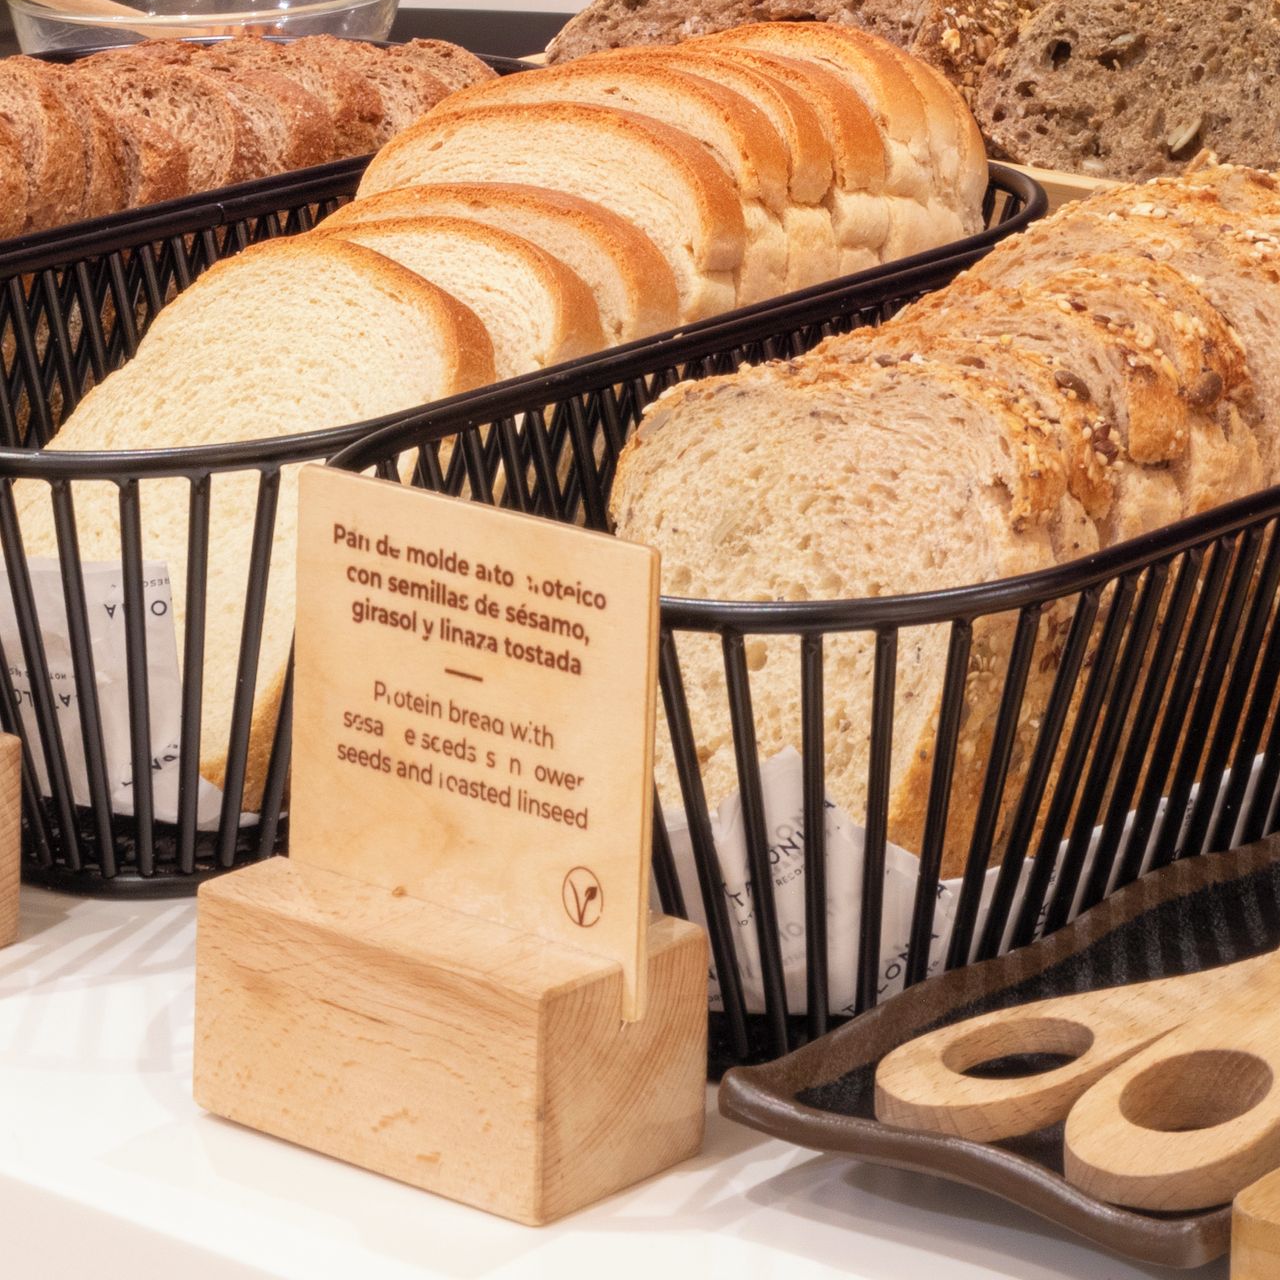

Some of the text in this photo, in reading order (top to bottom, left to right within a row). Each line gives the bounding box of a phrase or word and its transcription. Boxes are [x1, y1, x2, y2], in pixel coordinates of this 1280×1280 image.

[333, 522, 371, 553] Pan
[405, 544, 471, 577] molde
[526, 575, 607, 612] oteico
[346, 564, 590, 646] con semillas de sésamo,
[351, 597, 583, 677] girasol y linaza tostada
[343, 710, 416, 746] sesae
[337, 742, 392, 774] seeds
[396, 760, 434, 786] and
[517, 789, 589, 831] linseed
